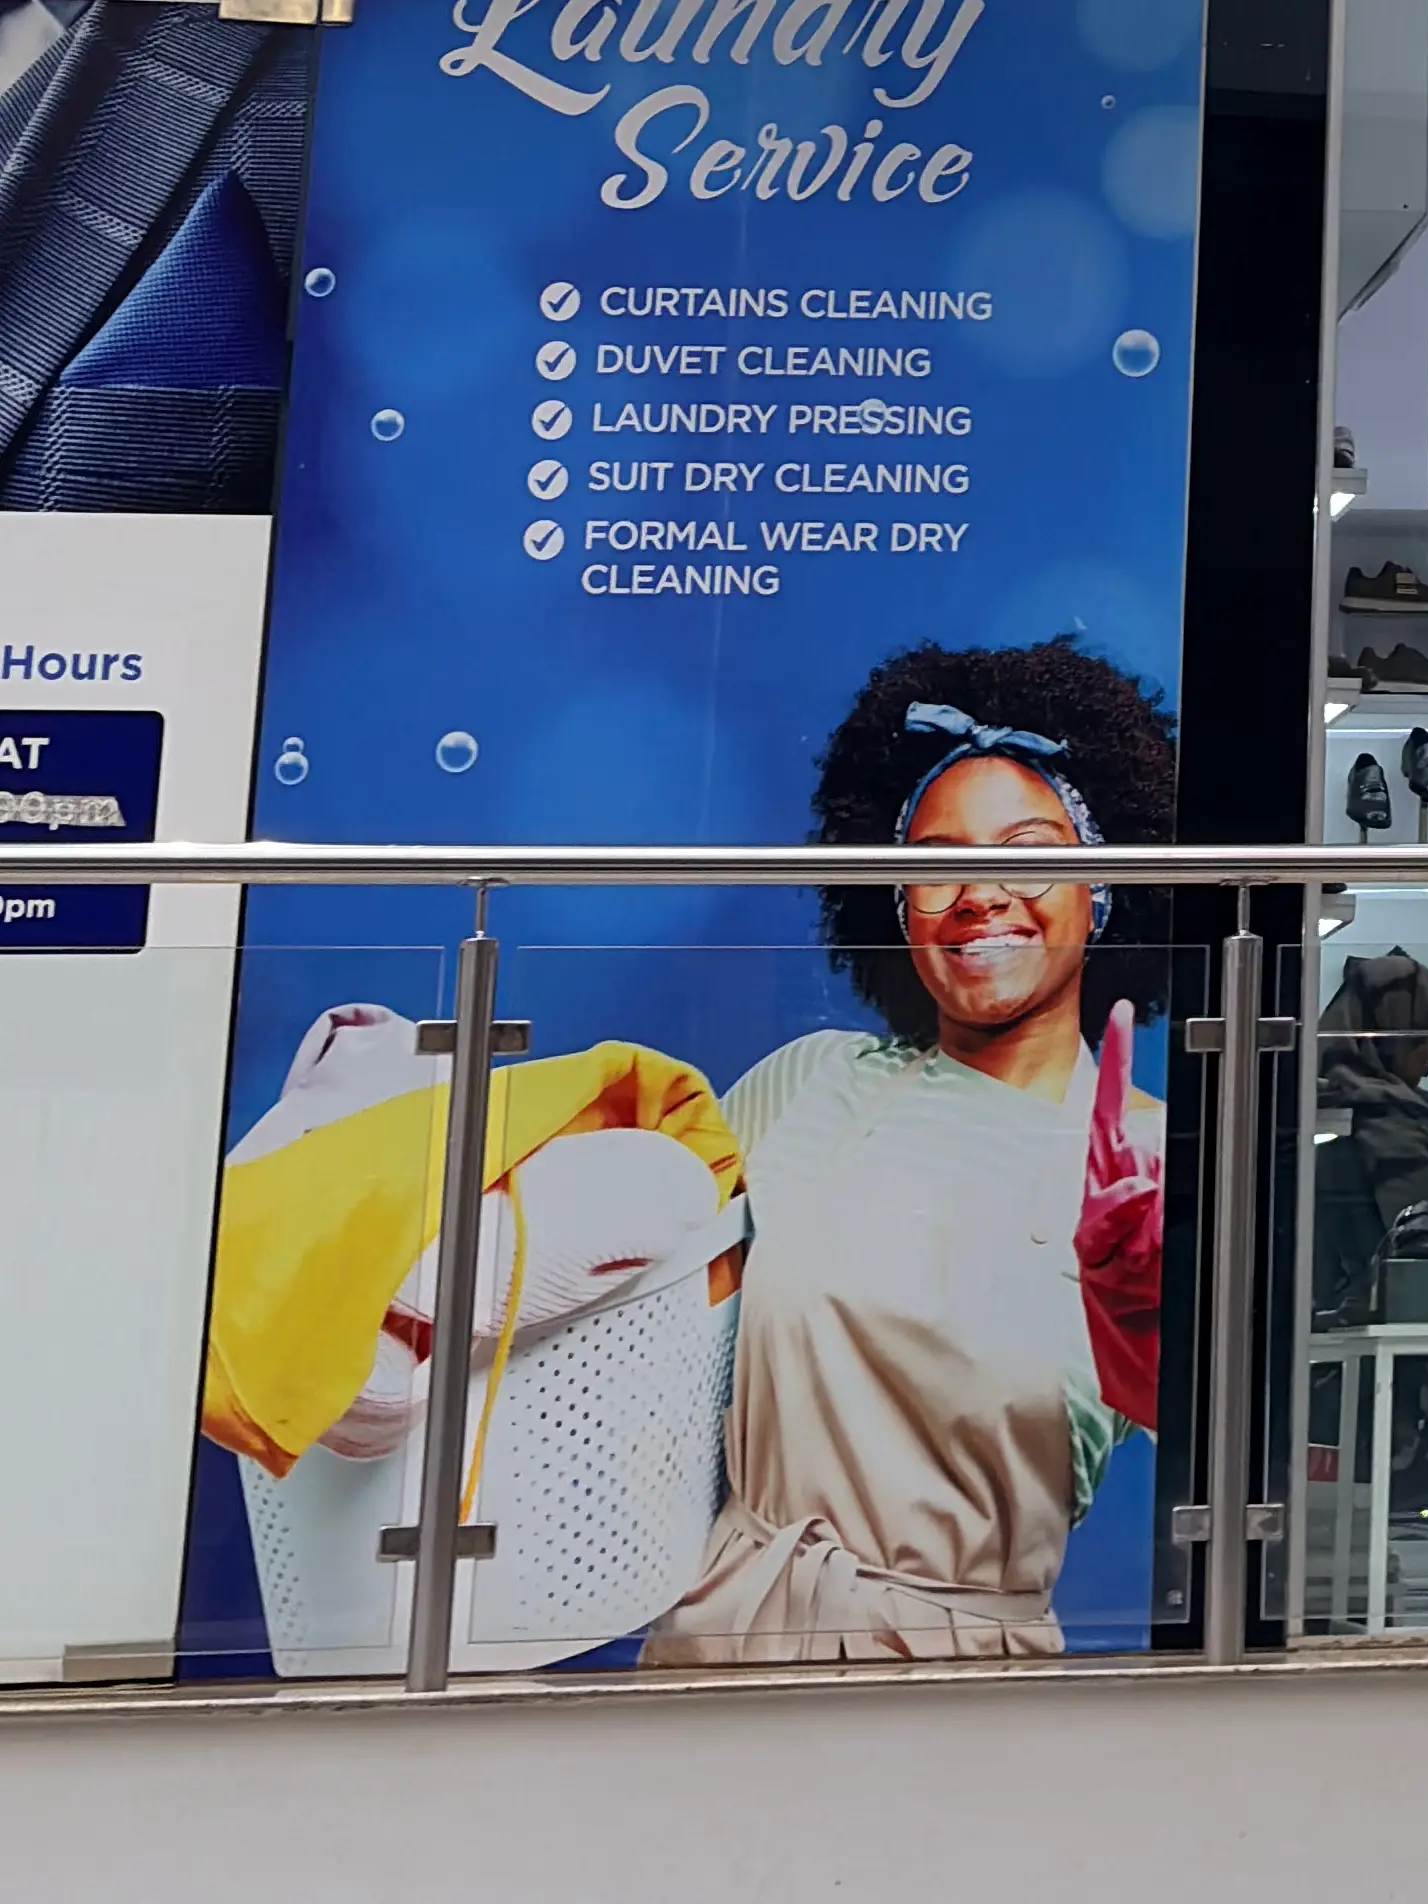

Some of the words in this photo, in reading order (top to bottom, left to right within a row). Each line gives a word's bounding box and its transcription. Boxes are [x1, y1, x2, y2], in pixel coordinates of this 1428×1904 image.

[600, 84, 973, 209] Service
[600, 286, 788, 318] CURTAINS
[800, 288, 993, 321] CLEANING
[596, 345, 726, 375] DUVET
[737, 346, 931, 378] CLEANING
[592, 403, 776, 434] LAUNDRY
[788, 400, 972, 436] PRESSING
[588, 462, 673, 492] SUIT
[685, 463, 764, 492] DRY
[774, 463, 970, 494] CLEANING
[584, 520, 748, 551] FORMAL
[760, 522, 878, 552] WEAR
[891, 522, 969, 553] DRY
[581, 564, 780, 595] CLEANING
[1, 644, 143, 681] Hours
[0, 895, 56, 923] pm
